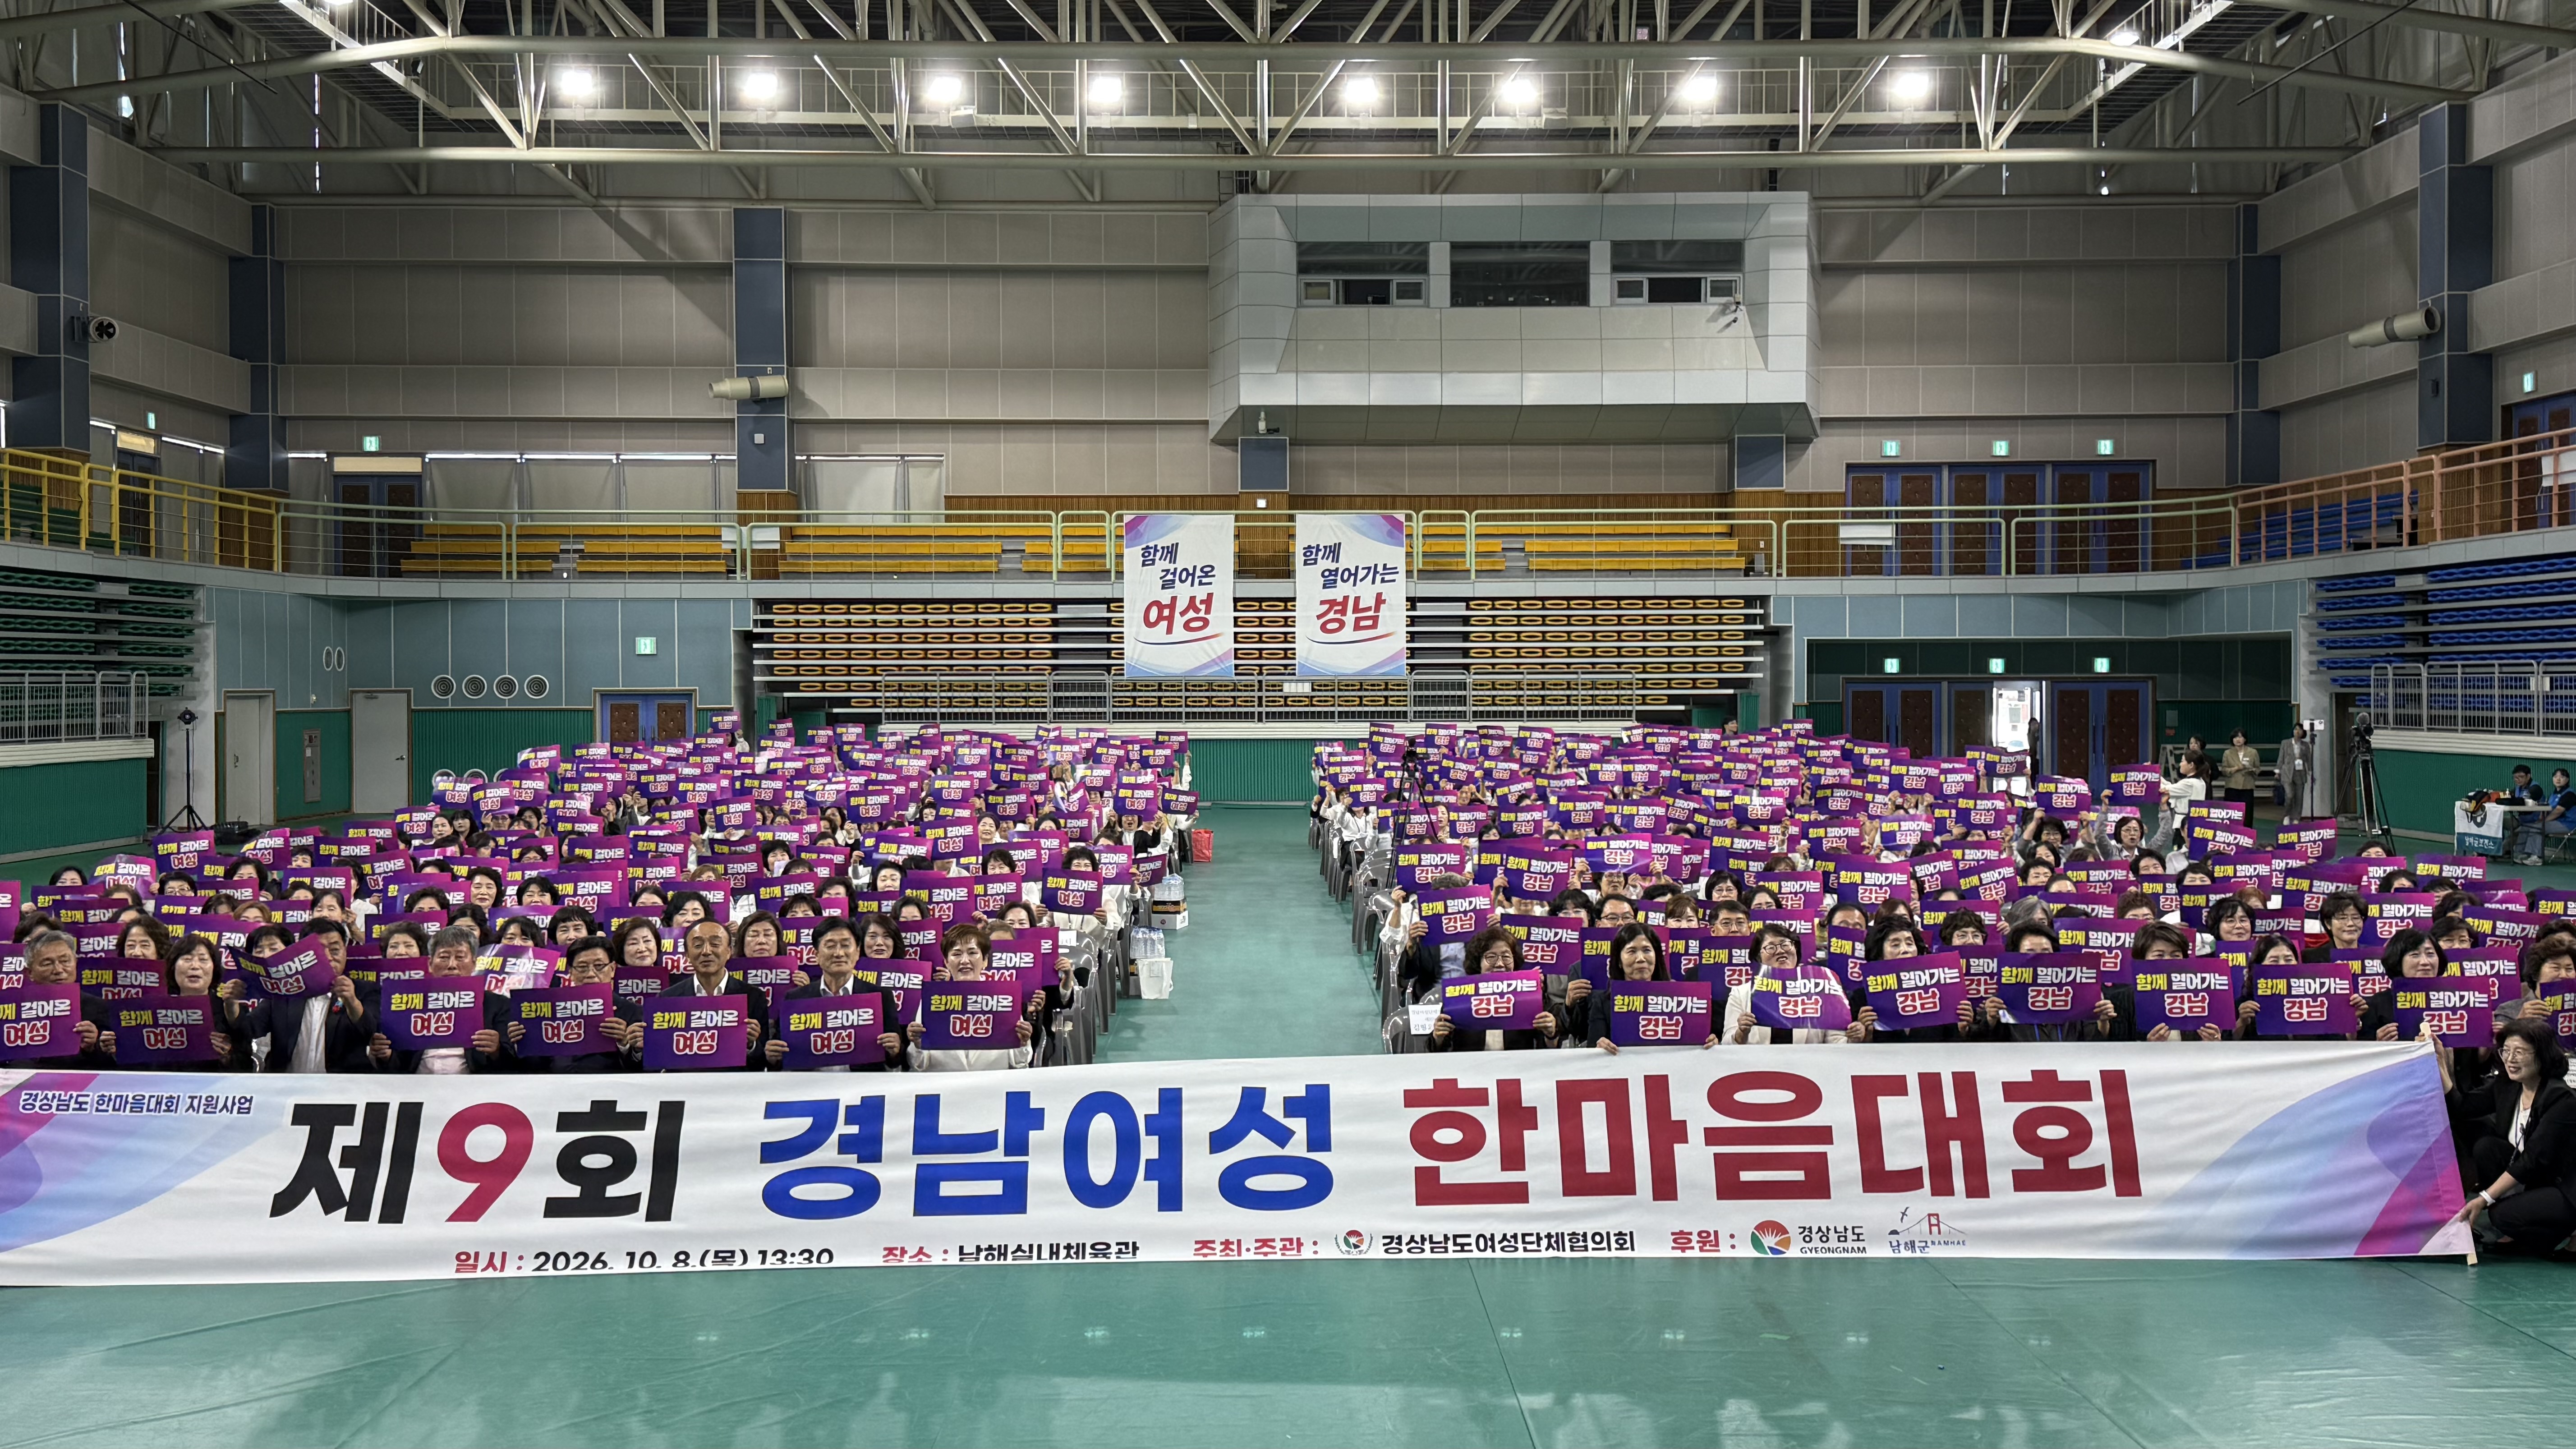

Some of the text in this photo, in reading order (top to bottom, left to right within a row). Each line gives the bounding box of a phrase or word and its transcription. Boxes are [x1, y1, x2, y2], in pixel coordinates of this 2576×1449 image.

[1141, 543, 1179, 566] 함께
[1303, 543, 1341, 566] 함께
[1159, 565, 1215, 590] 걸어온
[1321, 563, 1398, 589] 열어가는
[1144, 593, 1214, 635] 여성
[1316, 592, 1386, 634] 경남
[1909, 766, 1939, 776] 열어가는
[1903, 776, 1926, 788] 경남
[2123, 782, 2146, 796] 경남
[998, 804, 1017, 815] 여성
[1126, 798, 1146, 810] 여성
[1751, 795, 1784, 807] 열어가는
[860, 805, 881, 817] 여성
[1571, 811, 1593, 823] 경남
[1746, 804, 1773, 819] 경남
[1971, 810, 1995, 823] 경남
[947, 825, 973, 837] 걸어온
[1900, 821, 1932, 831] 열어가는
[938, 837, 963, 852] 여성
[1894, 829, 1921, 846] 경남
[2195, 828, 2253, 847] 함께 열어가는
[2279, 829, 2335, 843] 함께 열어가는
[158, 840, 208, 855] 함께 걸어온
[320, 845, 370, 856] 함께 걸어온
[595, 848, 624, 859] 걸어온
[880, 844, 927, 856] 함께 걸어온
[1604, 847, 1634, 866] 경남
[170, 852, 198, 869] 여성
[1399, 853, 1460, 865] 함께 열어가는
[1508, 857, 1568, 873] 함께 열어가는
[1864, 872, 1907, 885] 열어가는
[1961, 867, 2015, 889] 함께 열어가는
[2418, 865, 2483, 879] 함께 열어가는
[987, 882, 1016, 894] 걸어온
[1048, 878, 1097, 891] 함께 걸어온
[1523, 873, 1554, 892] 경남
[1977, 881, 2006, 902] 경남
[1058, 890, 1085, 907] 여성
[1858, 886, 1890, 903] 경남
[975, 895, 1005, 913] 여성
[1421, 897, 1490, 916] 함께 열어가는
[1442, 912, 1475, 934] 경남
[1530, 927, 1579, 943] 열어가는
[1523, 943, 1558, 963] 경남
[239, 950, 318, 977] 함께 걸어온
[476, 955, 548, 975] 함께 걸어온
[2463, 960, 2516, 976] 열어가는
[83, 970, 159, 986] 함께 걸어온
[881, 972, 923, 989] 걸어온
[1868, 967, 1960, 992] 함께 열어가는
[2002, 966, 2096, 983] 함께 열어가는
[2137, 973, 2228, 990] 함께 열어가는
[260, 975, 305, 994] 여성
[1445, 980, 1536, 998] 함께 열어가는
[1755, 977, 1843, 995] 함께 열어가는
[2259, 978, 2349, 995] 함께 열어가는
[391, 991, 474, 1010] 함께 걸어온
[932, 995, 1012, 1011] 함께 걸어온
[1471, 994, 1514, 1017] 경남
[1615, 996, 1707, 1013] 함께 열어가는
[1778, 994, 1822, 1017] 경남
[1896, 988, 1940, 1015] 경남
[2028, 986, 2073, 1010] 경남
[2164, 993, 2209, 1017] 경남
[2398, 991, 2488, 1008] 함께 열어가는
[21, 999, 70, 1018] 걸어온
[522, 999, 603, 1017] 함께 걸어온
[2284, 997, 2328, 1021] 경남
[120, 1009, 203, 1027] 함께 걸어온
[411, 1012, 455, 1035] 여성
[654, 1010, 738, 1029] 함께 걸어온
[791, 1008, 874, 1030] 함께 걸어온
[950, 1014, 993, 1037] 여성
[2422, 1010, 2467, 1037] 경남
[4, 1020, 50, 1046] 여성
[542, 1019, 584, 1043] 여성
[1639, 1016, 1683, 1039] 경남
[143, 1027, 187, 1049] 여성
[673, 1030, 718, 1054] 여성
[811, 1029, 854, 1054] 여성
[21, 1092, 253, 1115] 경상남도 한마음대회 지원사업
[271, 1069, 2143, 1224] 제9회 경남여성 한마음대회
[1381, 1231, 1635, 1254] 경상남도여성단체협의회
[1798, 1225, 1865, 1243] 경상남도
[1800, 1246, 1867, 1255] GYEONGNAM
[1889, 1240, 1930, 1254] 남해군
